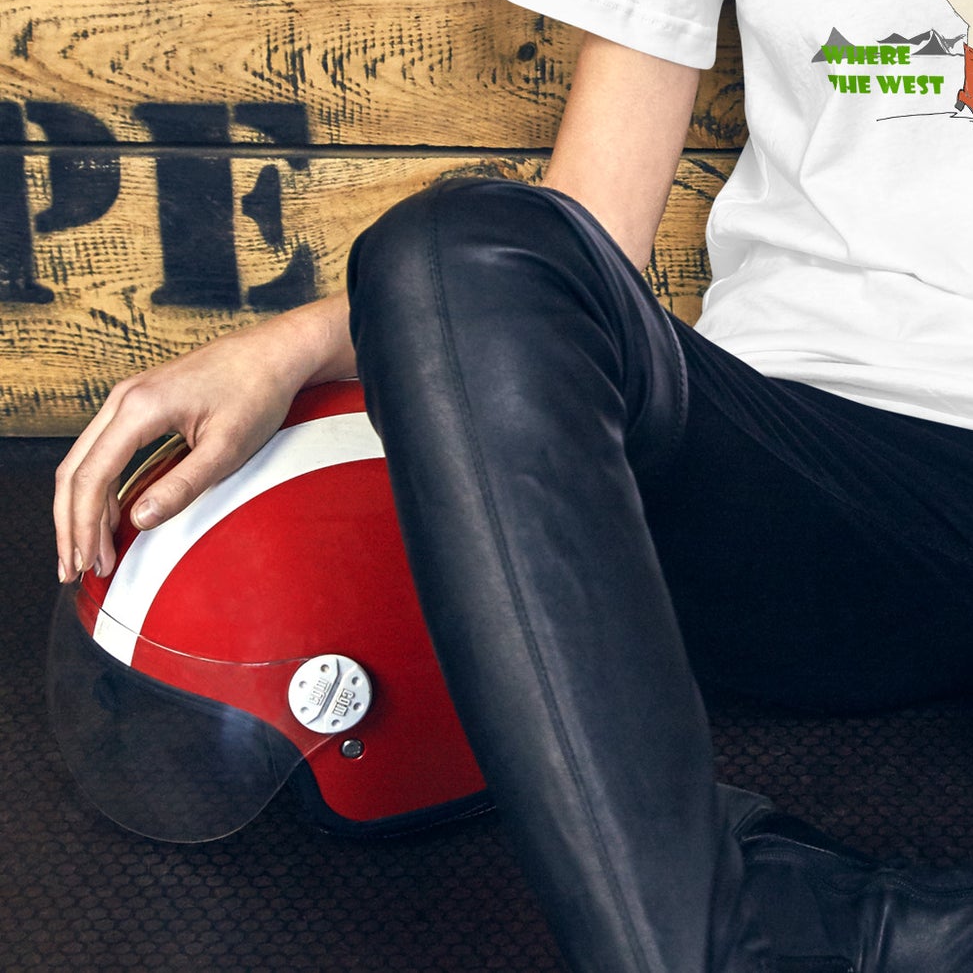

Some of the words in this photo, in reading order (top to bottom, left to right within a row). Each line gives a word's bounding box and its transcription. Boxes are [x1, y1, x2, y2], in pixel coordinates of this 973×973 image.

[821, 44, 911, 66] WHERE
[828, 74, 872, 95] THE
[875, 74, 945, 95] WEST
